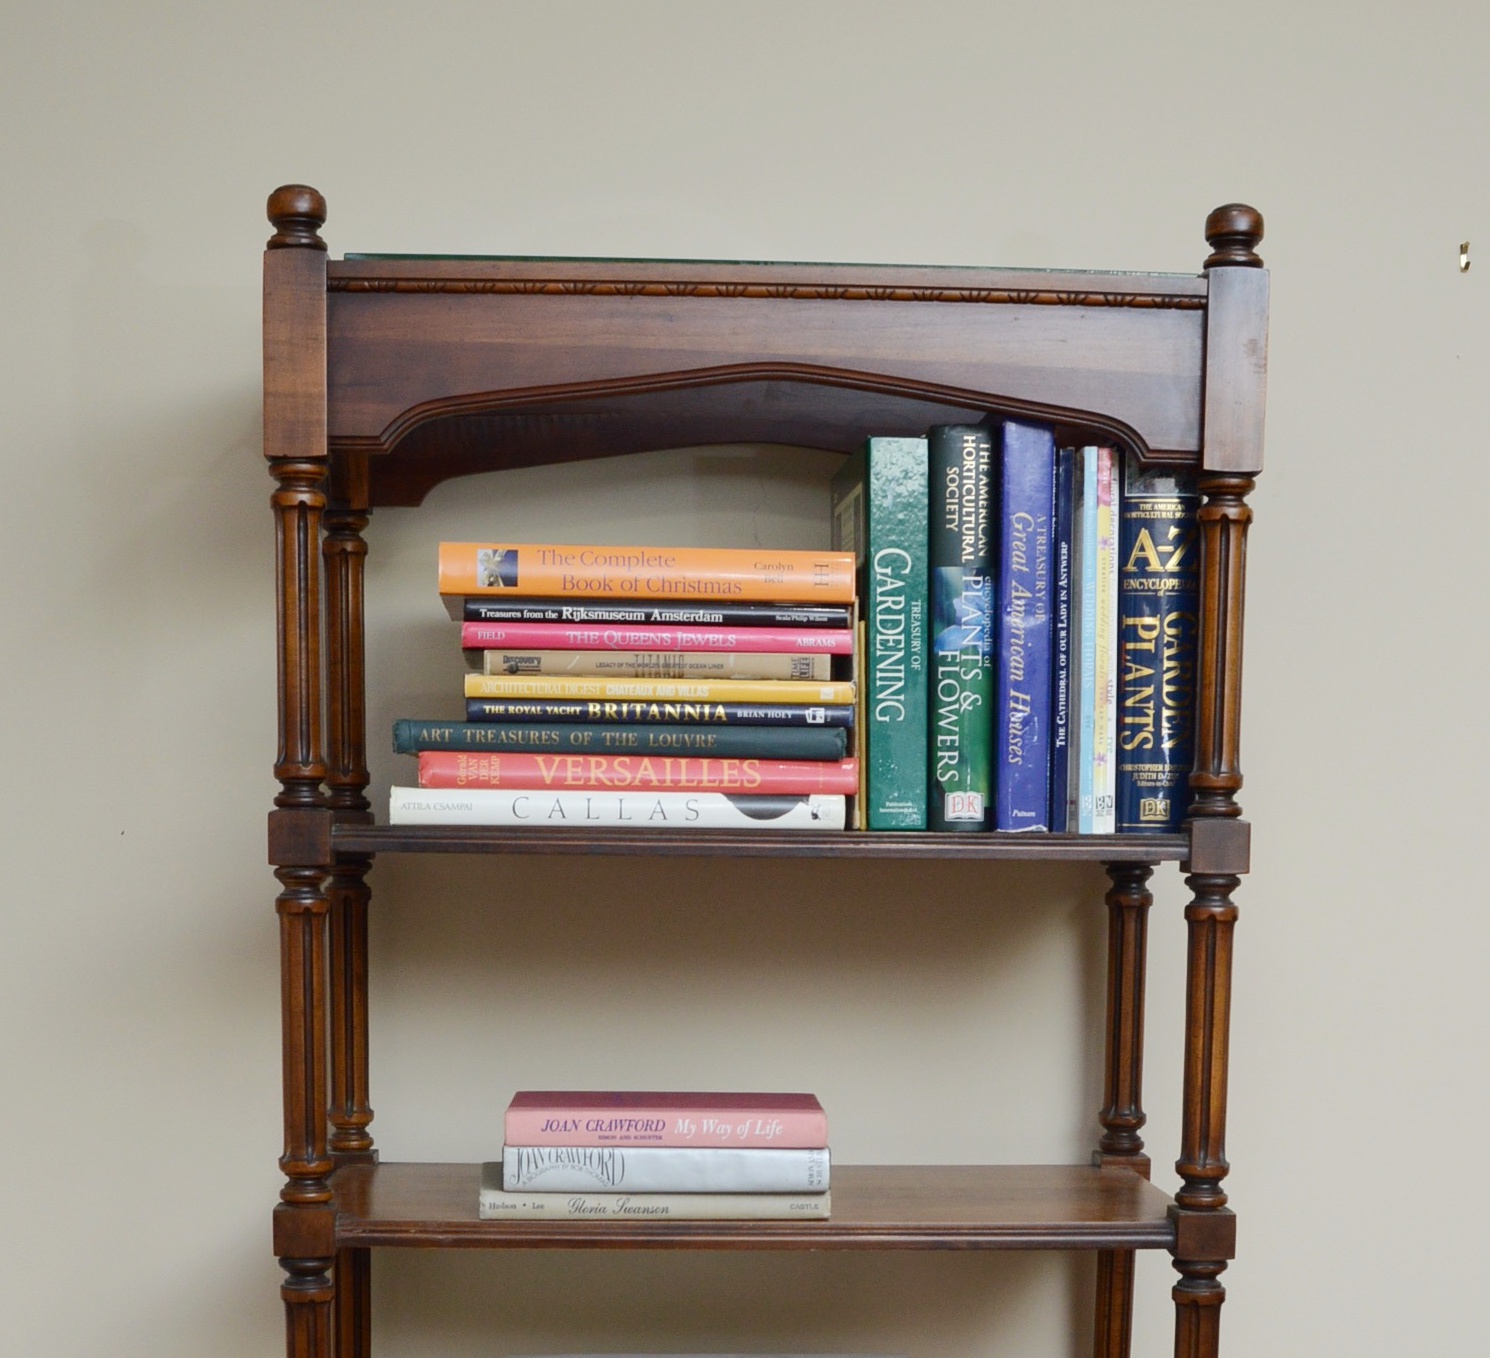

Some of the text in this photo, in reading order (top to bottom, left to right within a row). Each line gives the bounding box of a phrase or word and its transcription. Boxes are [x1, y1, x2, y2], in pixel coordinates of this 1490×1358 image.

[945, 466, 960, 532] SOCIETY
[961, 435, 977, 563] HORTICULTURAL
[978, 443, 991, 557] THE AMERICAN
[1139, 503, 1153, 511] THE
[1109, 510, 1117, 575] decorations
[1122, 524, 1197, 573] A-Z
[537, 549, 675, 573] The Complete
[754, 562, 794, 572] Carolyn
[1034, 513, 1047, 622] A TREASURY OF
[562, 574, 743, 595] Book of Christmas
[479, 606, 724, 623] Treasures from the Rijksmuseum Amsterdam
[982, 575, 994, 668] encyclopedia of
[477, 631, 506, 640] FIELD
[566, 631, 600, 644] THE
[674, 631, 736, 650] JEWELS
[796, 638, 837, 648] ABRAMS
[873, 547, 912, 723] GARDENING
[910, 599, 922, 671] TREASURY OF
[960, 575, 984, 714] PLANTS &
[1008, 511, 1035, 766] Great American Houses
[1056, 541, 1068, 748] THE CATHEDRAL OF OUR LADY IN ANTWERP
[595, 661, 617, 669] LEGACY
[791, 657, 799, 679] TIME
[800, 657, 811, 679] LIFE
[480, 682, 709, 698] ARCHITECTURAL DIGEST CHATEAUX AND VILLAS
[1119, 614, 1161, 751] PLANTS
[1161, 611, 1196, 749] GARDEN
[483, 702, 728, 722] THE ROYAL YACHT BRITANNIA
[737, 710, 765, 719] BRIAN
[936, 650, 960, 782] FLOWERS
[419, 728, 717, 748] ART TREASURES OF THE LOUVRE
[468, 758, 479, 781] VAN
[479, 759, 489, 781] DER
[490, 755, 500, 785] KEMP
[535, 755, 762, 788] VERSAILLES
[400, 802, 473, 812] ATTILA CSAMPAI
[951, 795, 979, 815] DK
[1145, 799, 1167, 816] DK
[541, 1119, 666, 1132] JOAN CRAWFORD
[674, 1119, 784, 1139] My Way of Life
[508, 1148, 625, 1187] JOAN CRAWFORD
[489, 1202, 545, 1210] Hudson Lee
[567, 1197, 670, 1215] Gloria Swanson
